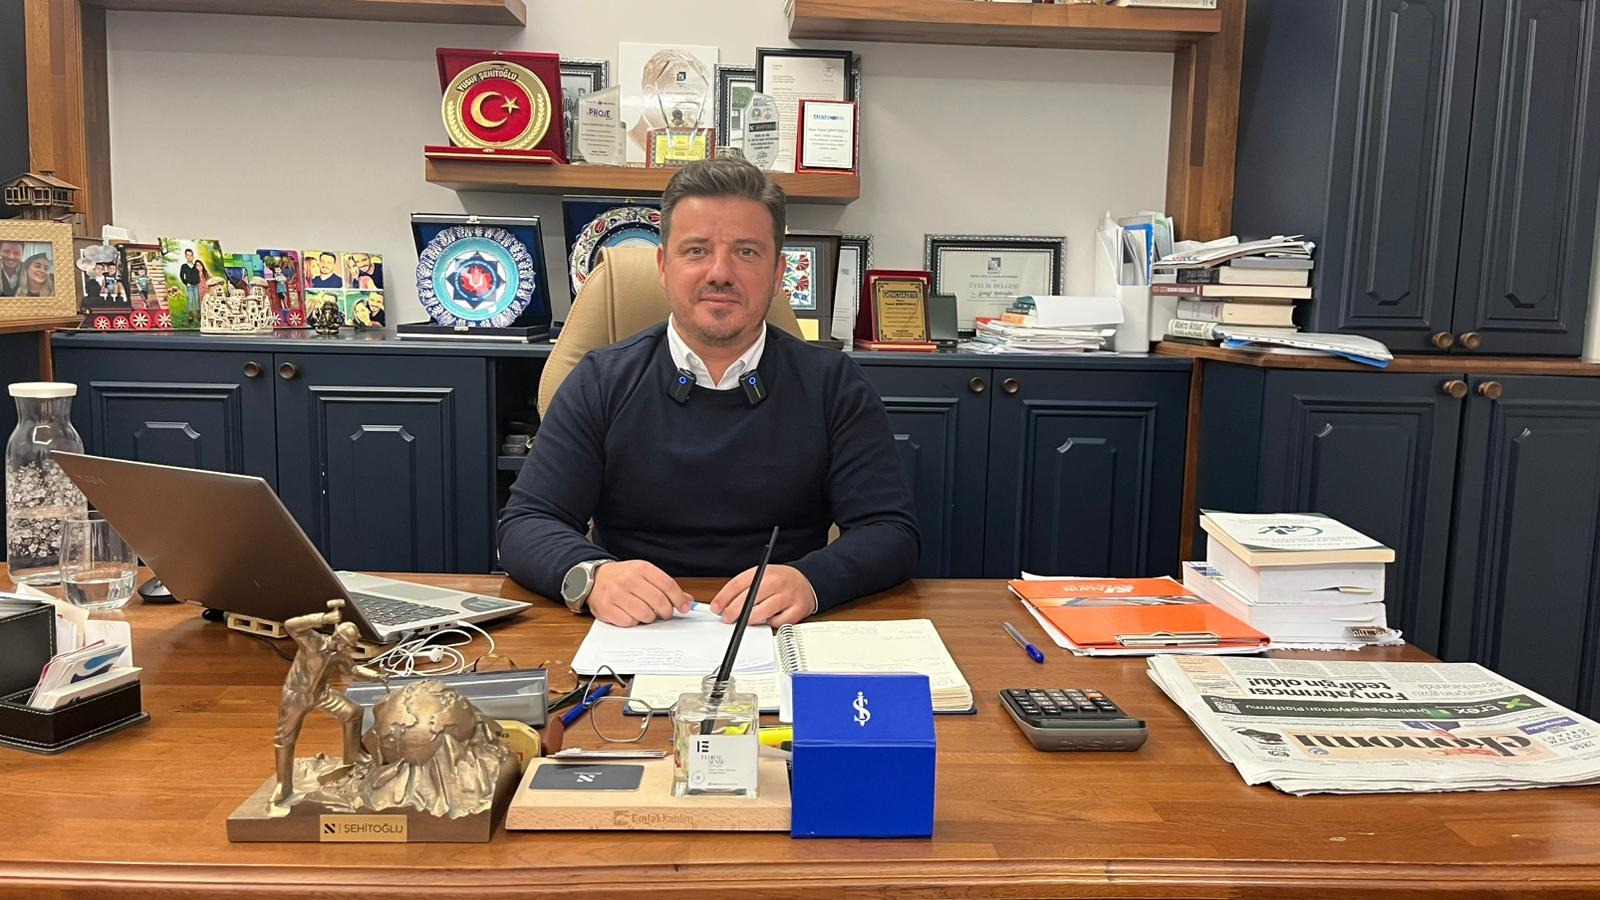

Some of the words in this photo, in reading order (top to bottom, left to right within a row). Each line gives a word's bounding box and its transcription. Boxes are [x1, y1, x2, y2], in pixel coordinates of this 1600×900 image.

[457, 75, 478, 91] YUSUF
[589, 108, 611, 118] PROJE
[1246, 678, 1302, 688] oldu!
[1304, 679, 1391, 690] tedirgin
[1248, 688, 1363, 698] yatırımcısı
[1364, 691, 1409, 700] Fon
[1293, 734, 1531, 757] ekonomi
[343, 823, 404, 834] ŞEHİTOĞLU
